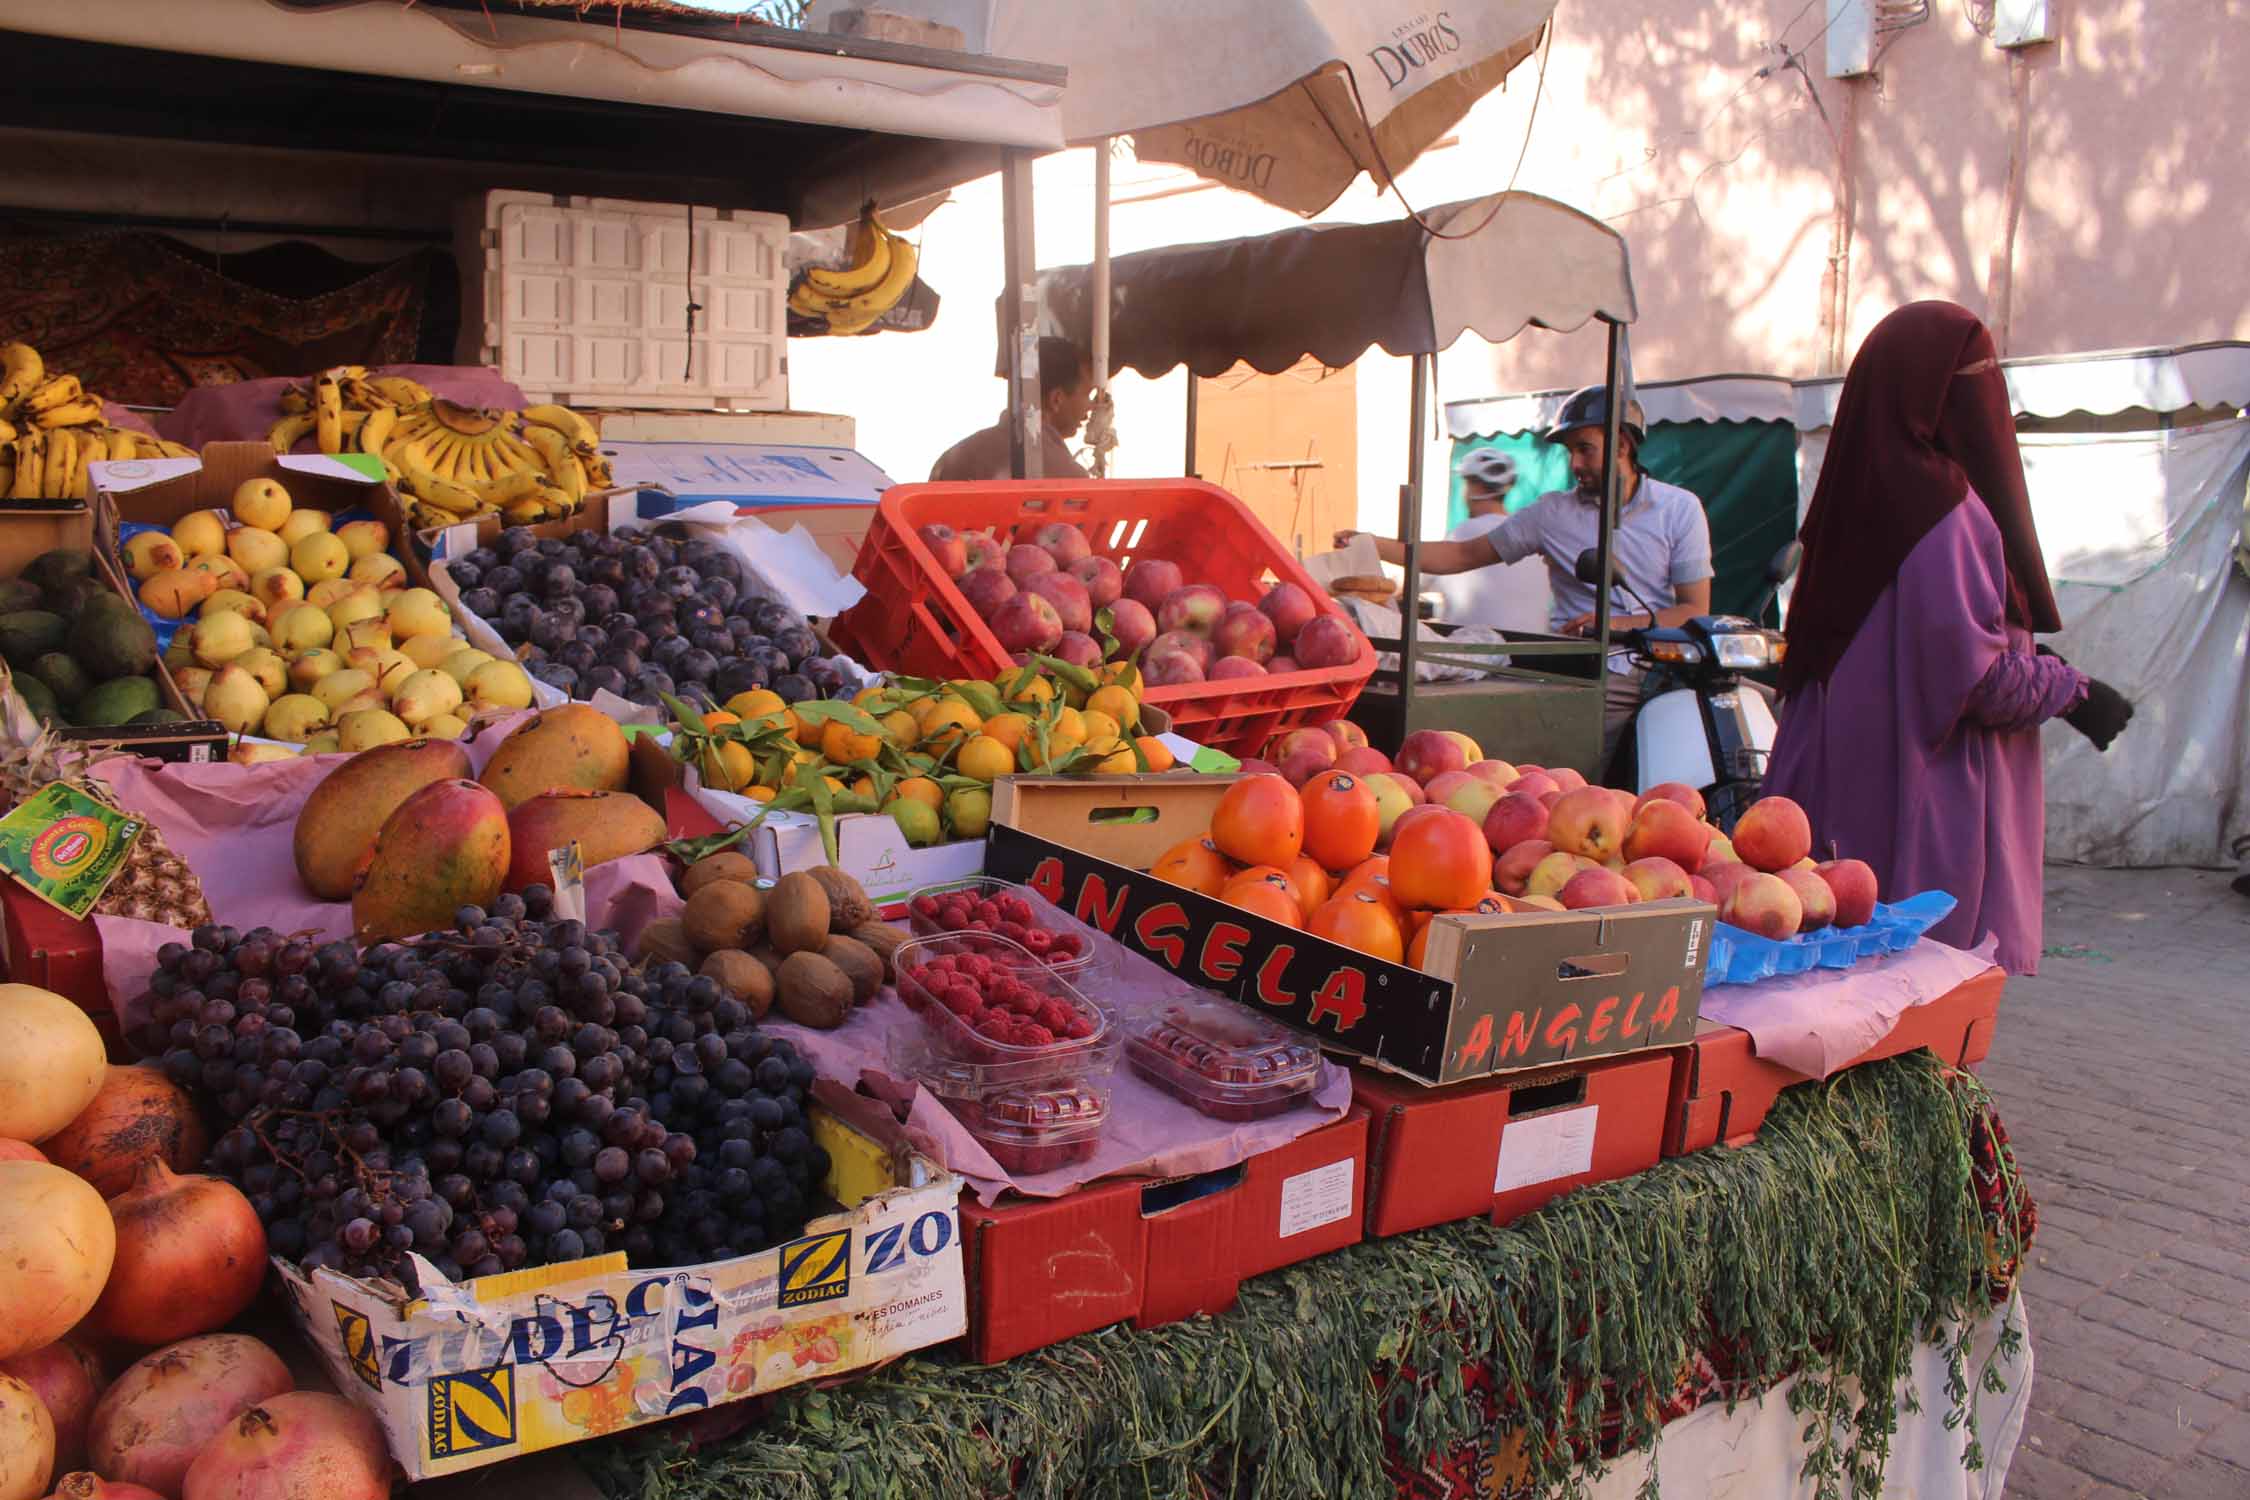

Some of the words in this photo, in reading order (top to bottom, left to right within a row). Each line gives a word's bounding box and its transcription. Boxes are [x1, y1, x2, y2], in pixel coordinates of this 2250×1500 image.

[1028, 857, 1367, 1032] ANGELA
[1456, 984, 1681, 1072] ANGELA
[864, 1203, 962, 1276] ZO
[783, 1282, 846, 1305] ZODIAC
[889, 1289, 944, 1315] DOMAINES
[431, 1380, 449, 1456] ZODIAC
